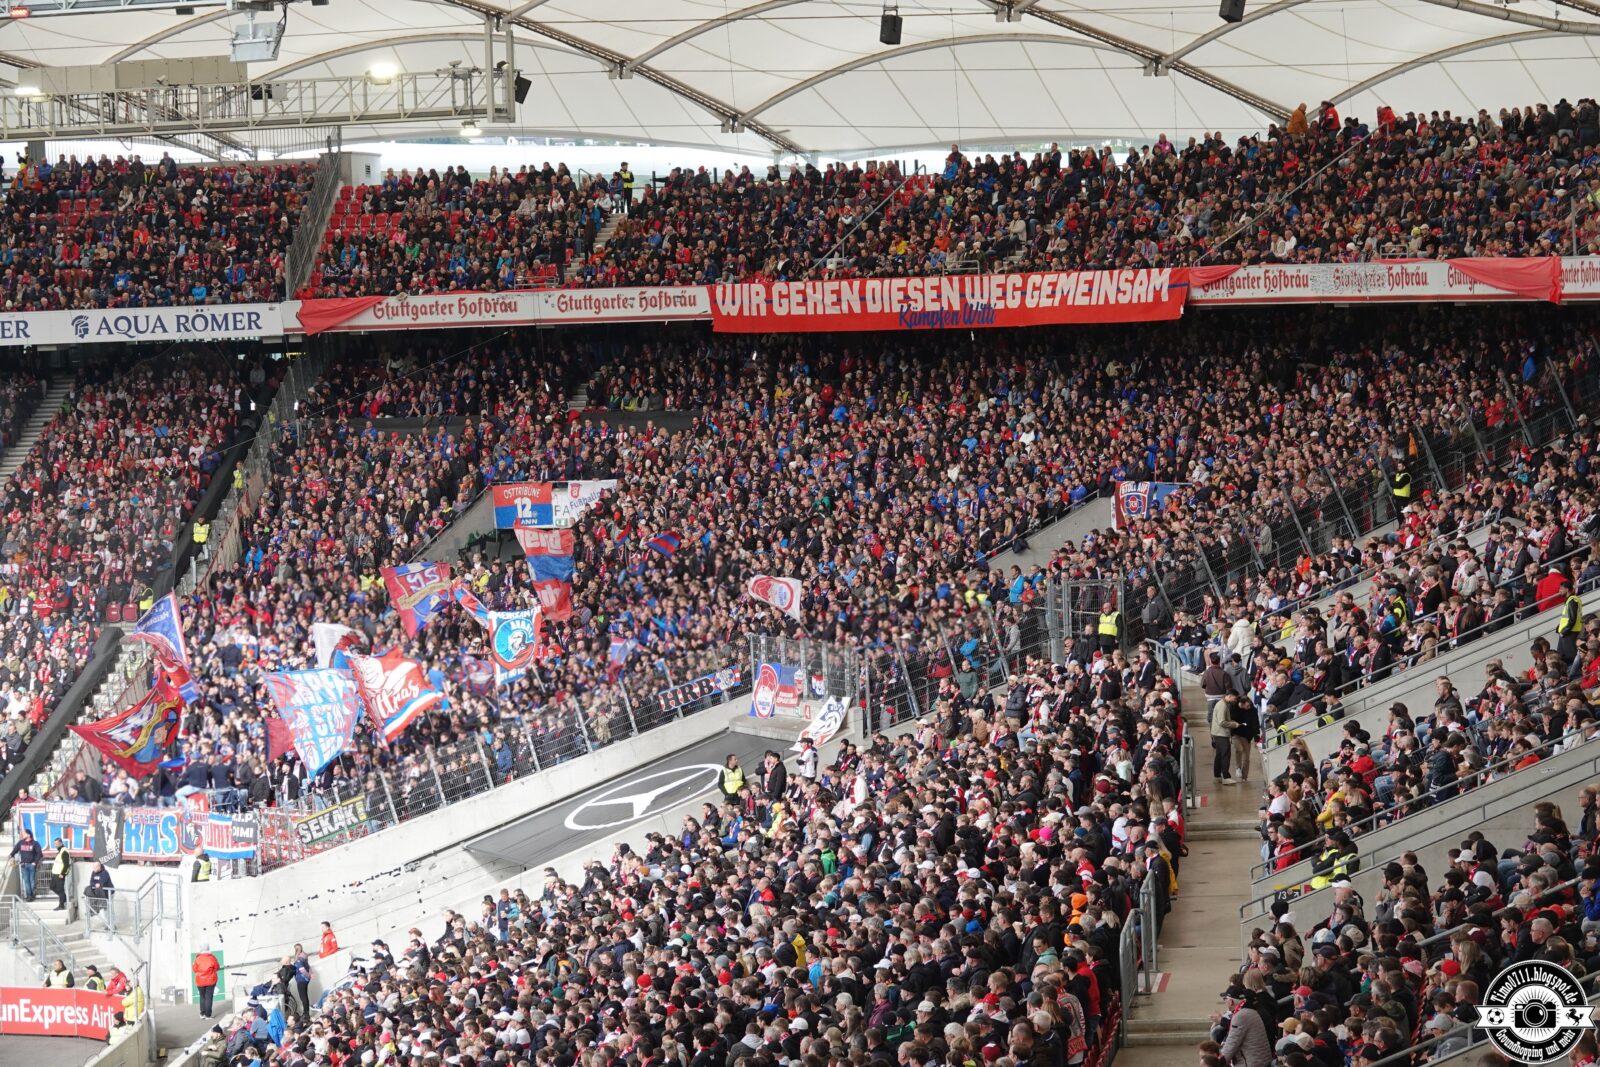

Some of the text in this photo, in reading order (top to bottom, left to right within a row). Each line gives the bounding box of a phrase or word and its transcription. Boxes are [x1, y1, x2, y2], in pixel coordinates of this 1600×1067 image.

[1263, 269, 1309, 293] Hofbräu
[1386, 265, 1429, 292] Hofbräu
[638, 290, 697, 312] Hofbräu
[715, 268, 1172, 316] WIR GEHEN DIESEN WEG GEMEINSAM
[373, 297, 518, 321] Stuttgarter Hofbräu
[96, 308, 263, 338] AQUA RÖMER
[91, 1003, 115, 1029] Airli
